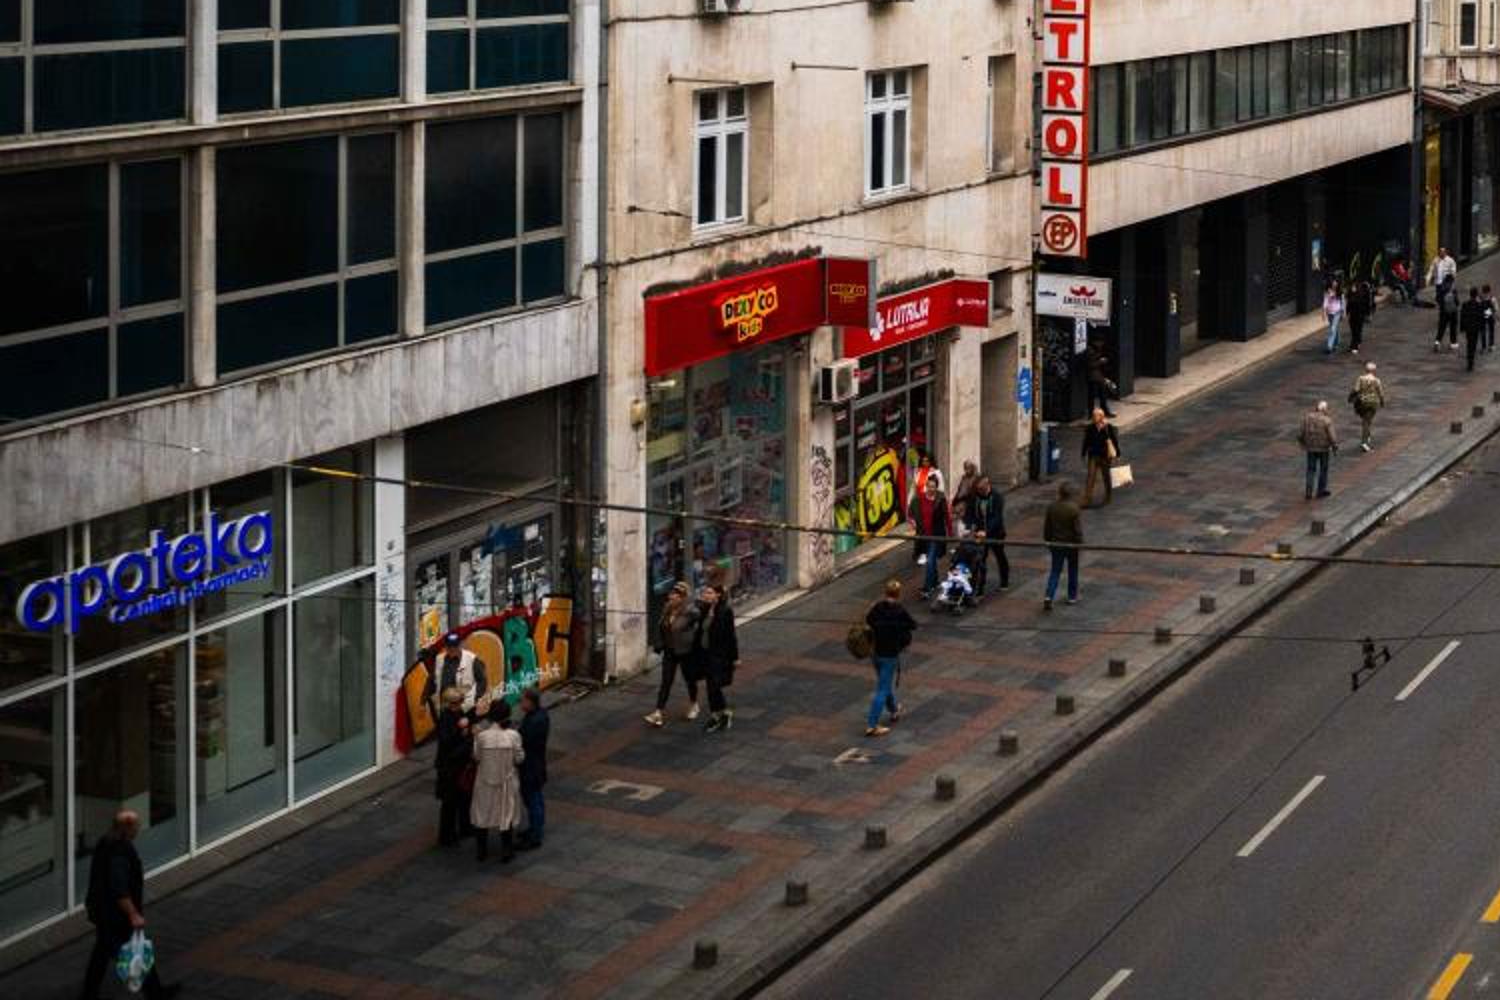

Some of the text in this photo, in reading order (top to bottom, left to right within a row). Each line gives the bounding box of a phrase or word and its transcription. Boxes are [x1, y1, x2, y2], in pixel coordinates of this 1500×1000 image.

[724, 291, 775, 321] DEXY CO
[16, 511, 273, 634] apoteka
